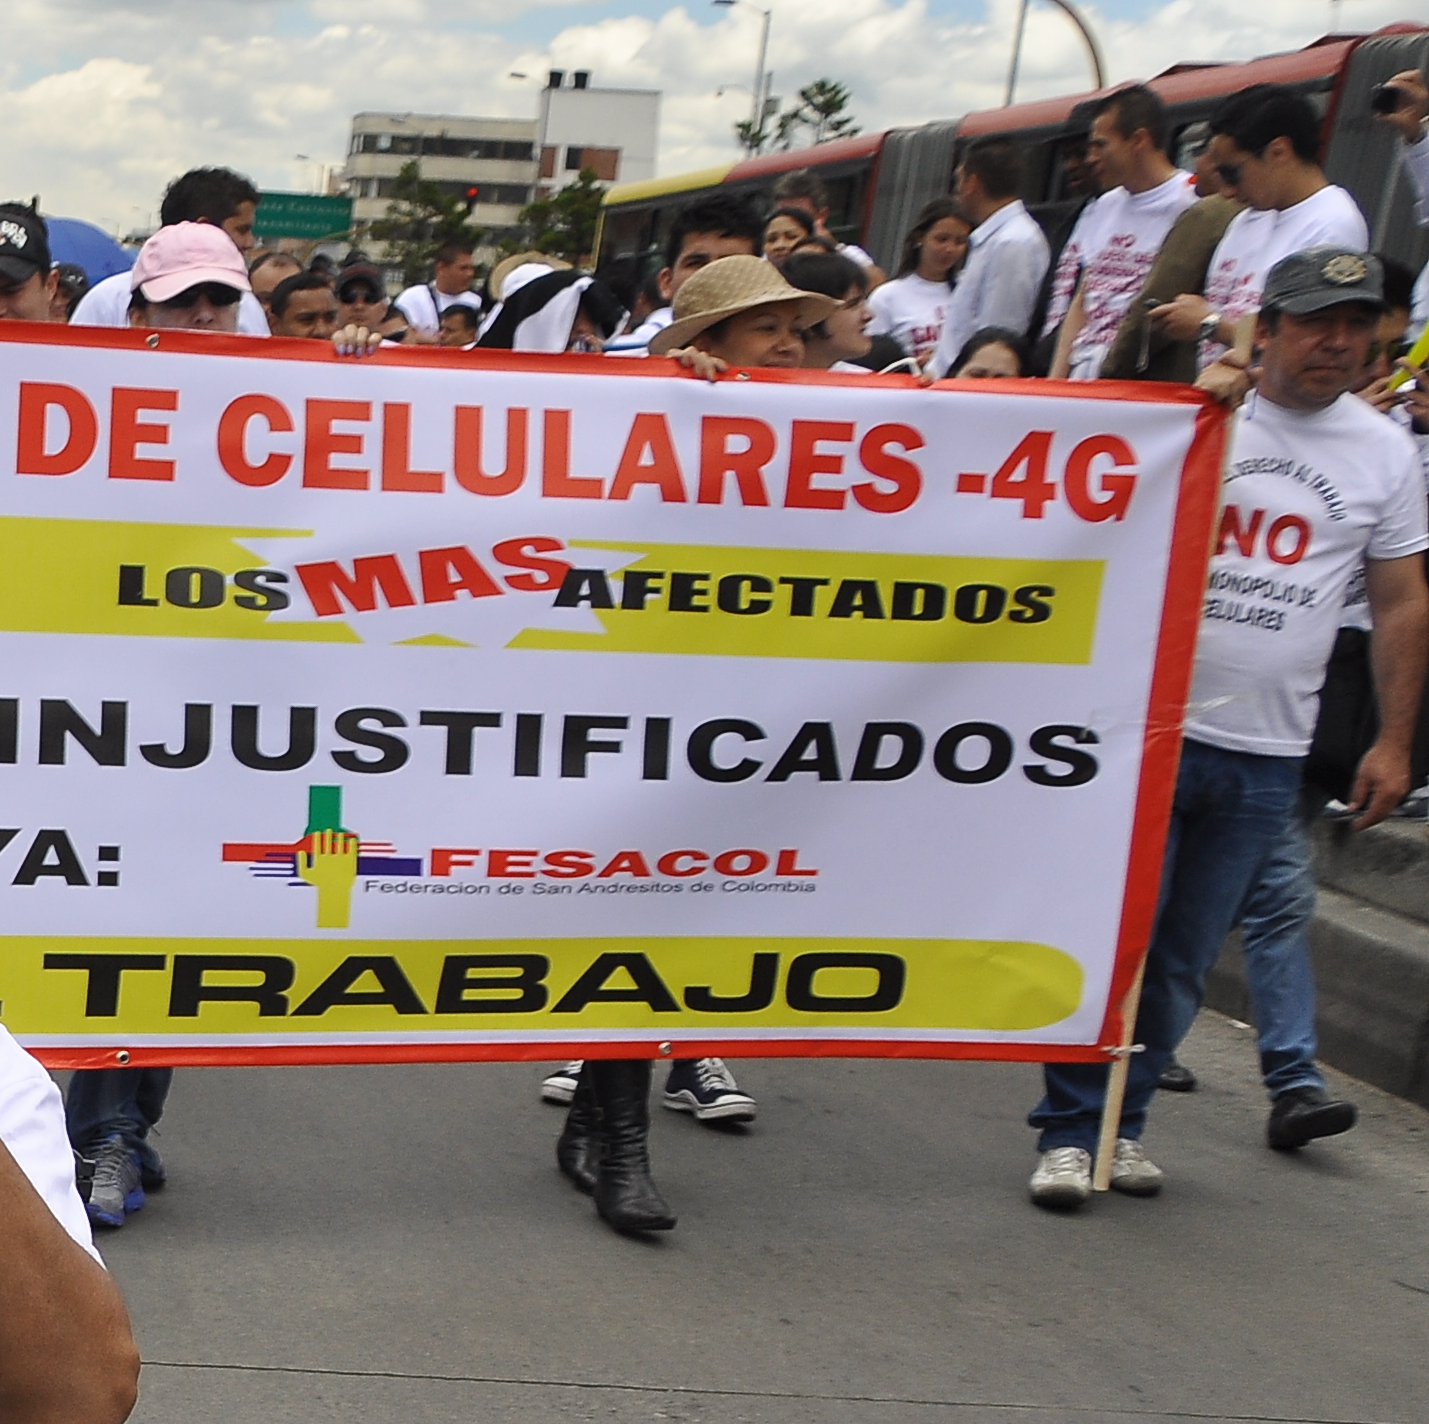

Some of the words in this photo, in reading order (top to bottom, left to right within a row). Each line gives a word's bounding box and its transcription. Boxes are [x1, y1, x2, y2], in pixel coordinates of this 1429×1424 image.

[15, 381, 179, 482] DE
[217, 393, 926, 514] CELULARES
[954, 431, 1139, 522] -4G
[1215, 504, 1311, 565] NO
[117, 564, 290, 612] LOS
[293, 536, 575, 617] MAS
[553, 567, 1055, 625] AFECTADOS
[1203, 598, 1286, 631] ELULARES
[365, 880, 491, 895] Federacion
[498, 881, 525, 895] de
[532, 882, 573, 895] San
[577, 880, 684, 894] Andresitos
[690, 881, 715, 893] de
[722, 880, 817, 893] Colombia
[429, 848, 819, 878] FESACOL
[43, 952, 905, 1018] TRABAJO
